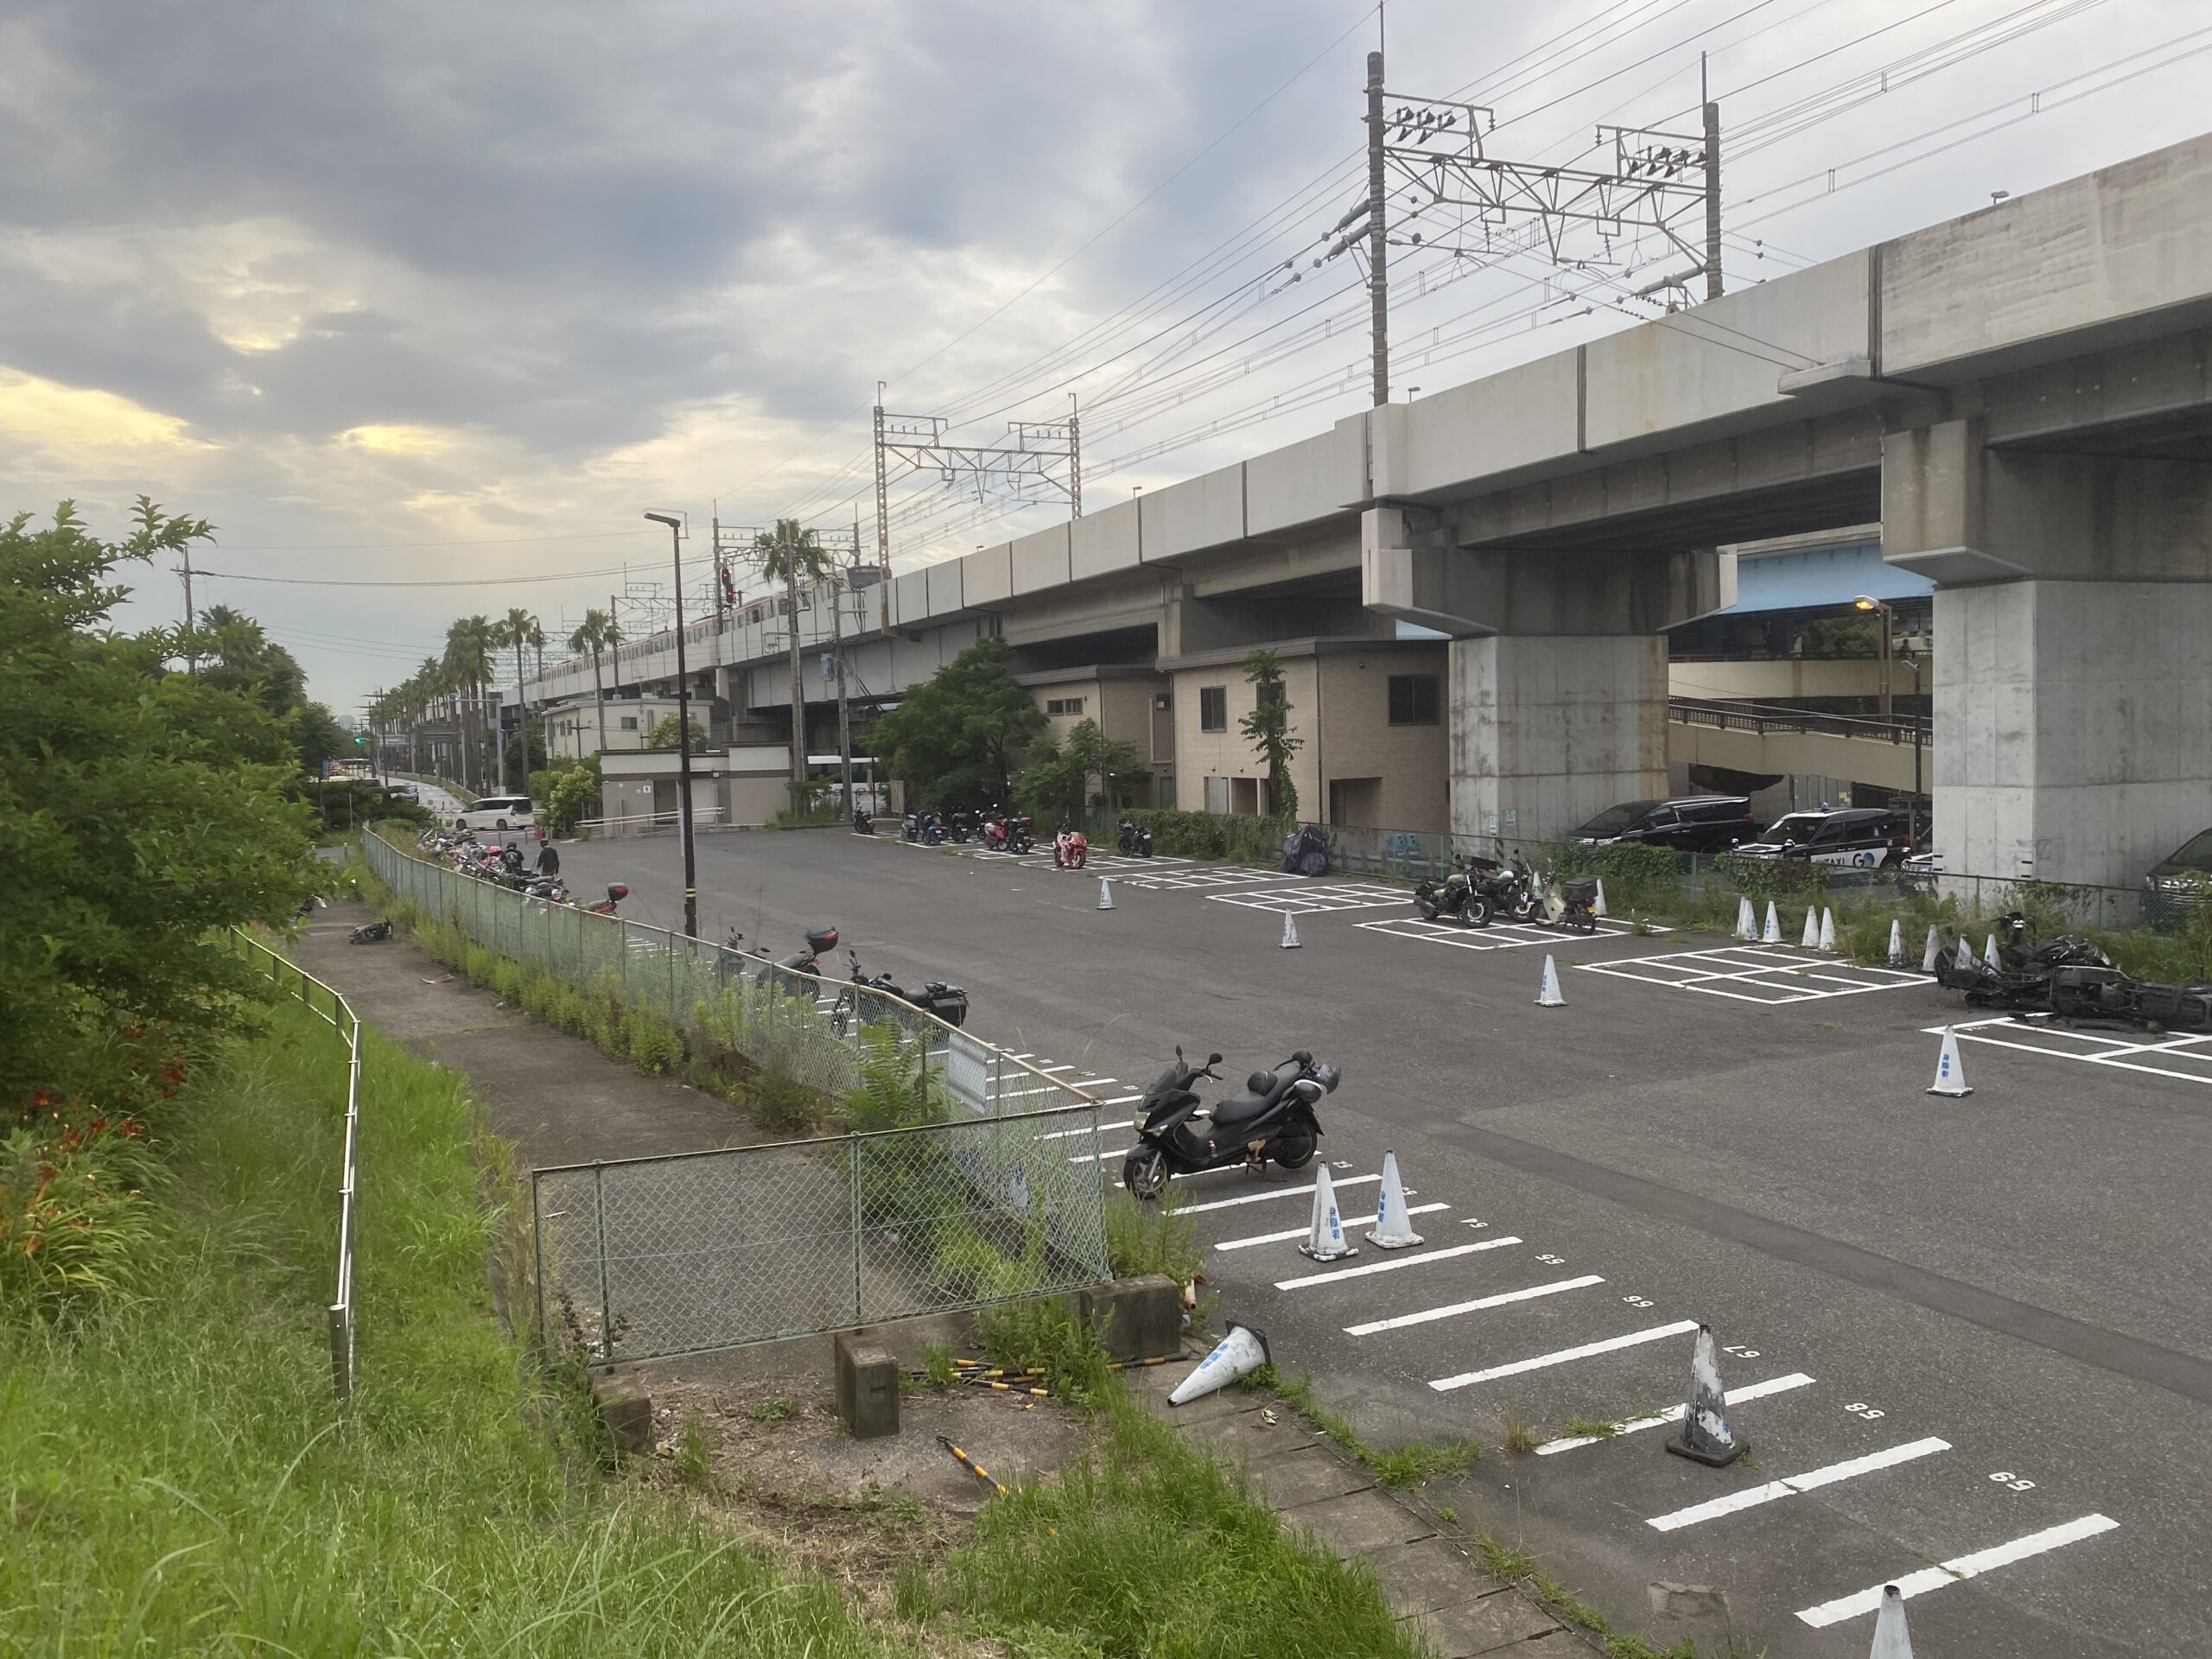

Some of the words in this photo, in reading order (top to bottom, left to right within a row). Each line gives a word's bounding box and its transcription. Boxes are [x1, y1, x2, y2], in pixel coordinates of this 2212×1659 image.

[1853, 853, 1875, 868] GO
[1459, 1217, 1489, 1228] 54
[1535, 1254, 1565, 1264] 55
[1623, 1295, 1655, 1307] 56
[1721, 1345, 1761, 1358] 57
[1844, 1402, 1885, 1420] 58
[1988, 1471, 2037, 1491] 59
